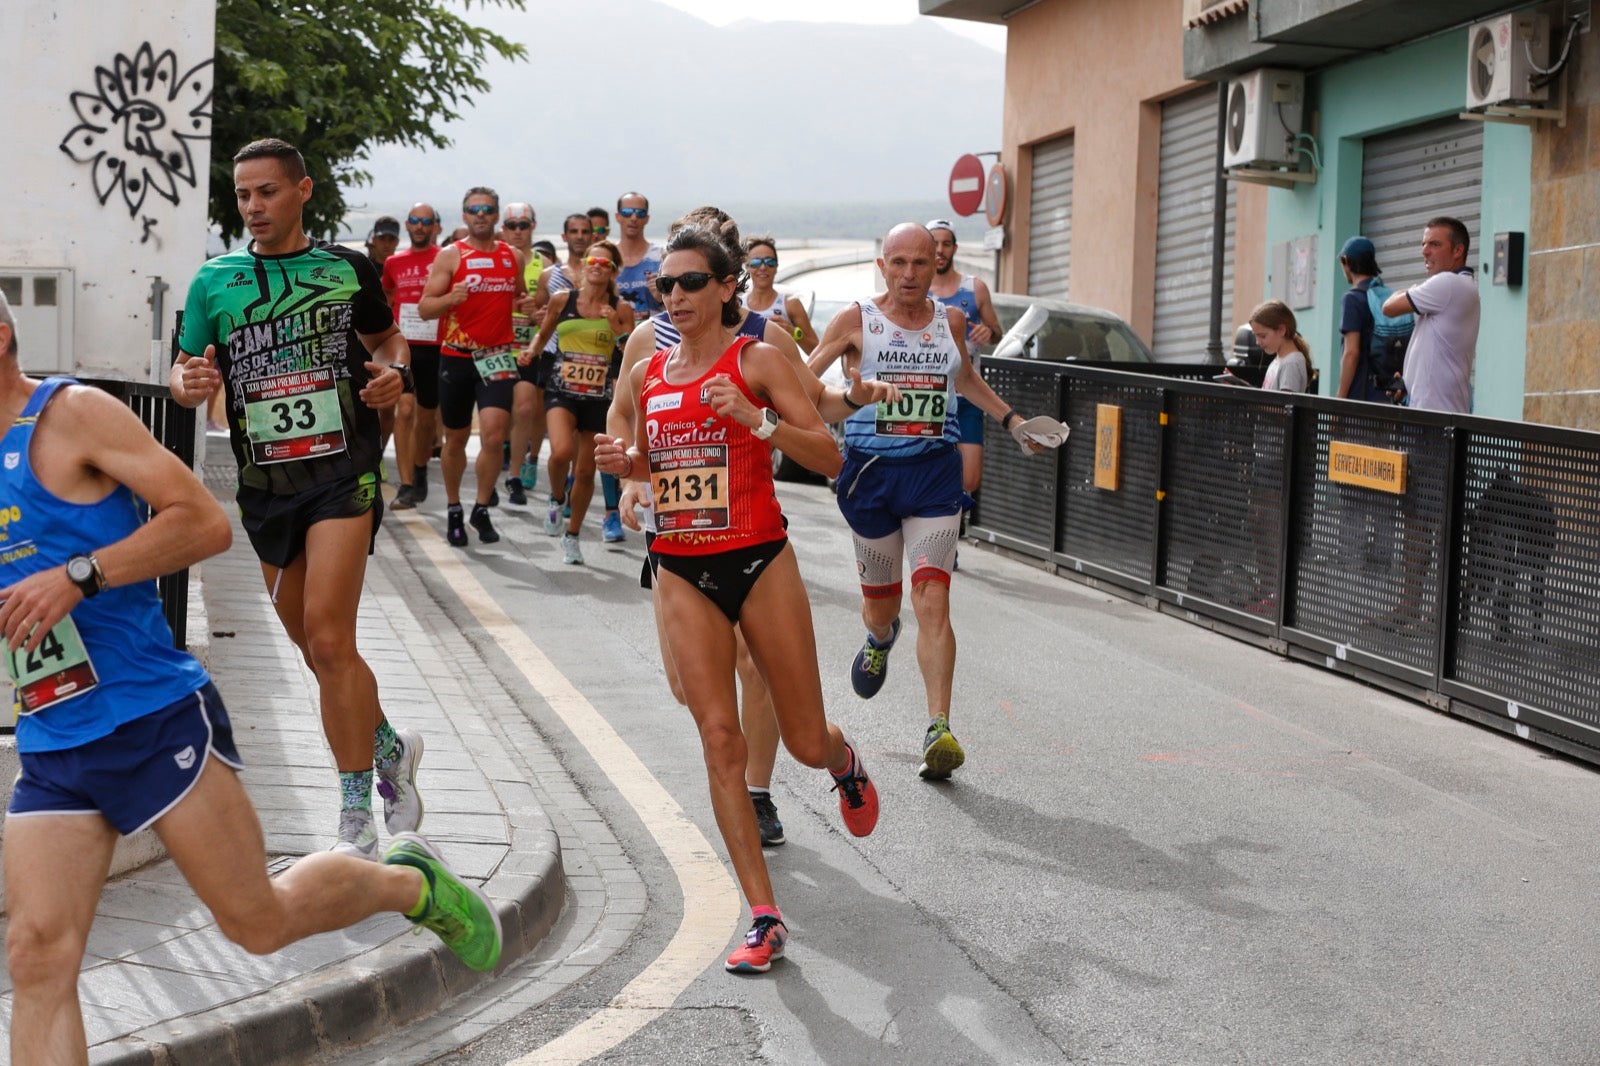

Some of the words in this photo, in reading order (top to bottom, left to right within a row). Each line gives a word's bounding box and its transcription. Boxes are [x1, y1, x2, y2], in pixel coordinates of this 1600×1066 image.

[226, 279, 253, 289] VIATOR
[228, 322, 273, 361] TEAM
[251, 351, 270, 368] DE
[272, 337, 320, 363] MENTE
[485, 355, 512, 370] 615
[877, 350, 948, 364] MARACENA
[260, 380, 277, 391] GRAN
[277, 375, 301, 388] PREMIO
[301, 373, 309, 384] DE
[309, 370, 330, 382] FONDO
[567, 365, 604, 382] 2107
[271, 399, 316, 433] 33
[881, 393, 945, 417] 1078
[646, 418, 727, 449] Polisalud
[662, 421, 696, 432] Clínicas
[660, 450, 673, 461] GRAN
[692, 448, 701, 459] DE
[701, 447, 721, 458] FONDO
[1334, 453, 1362, 476] CERVEZAS
[1362, 458, 1395, 482] ALHAMBRA
[658, 473, 718, 504] 2131
